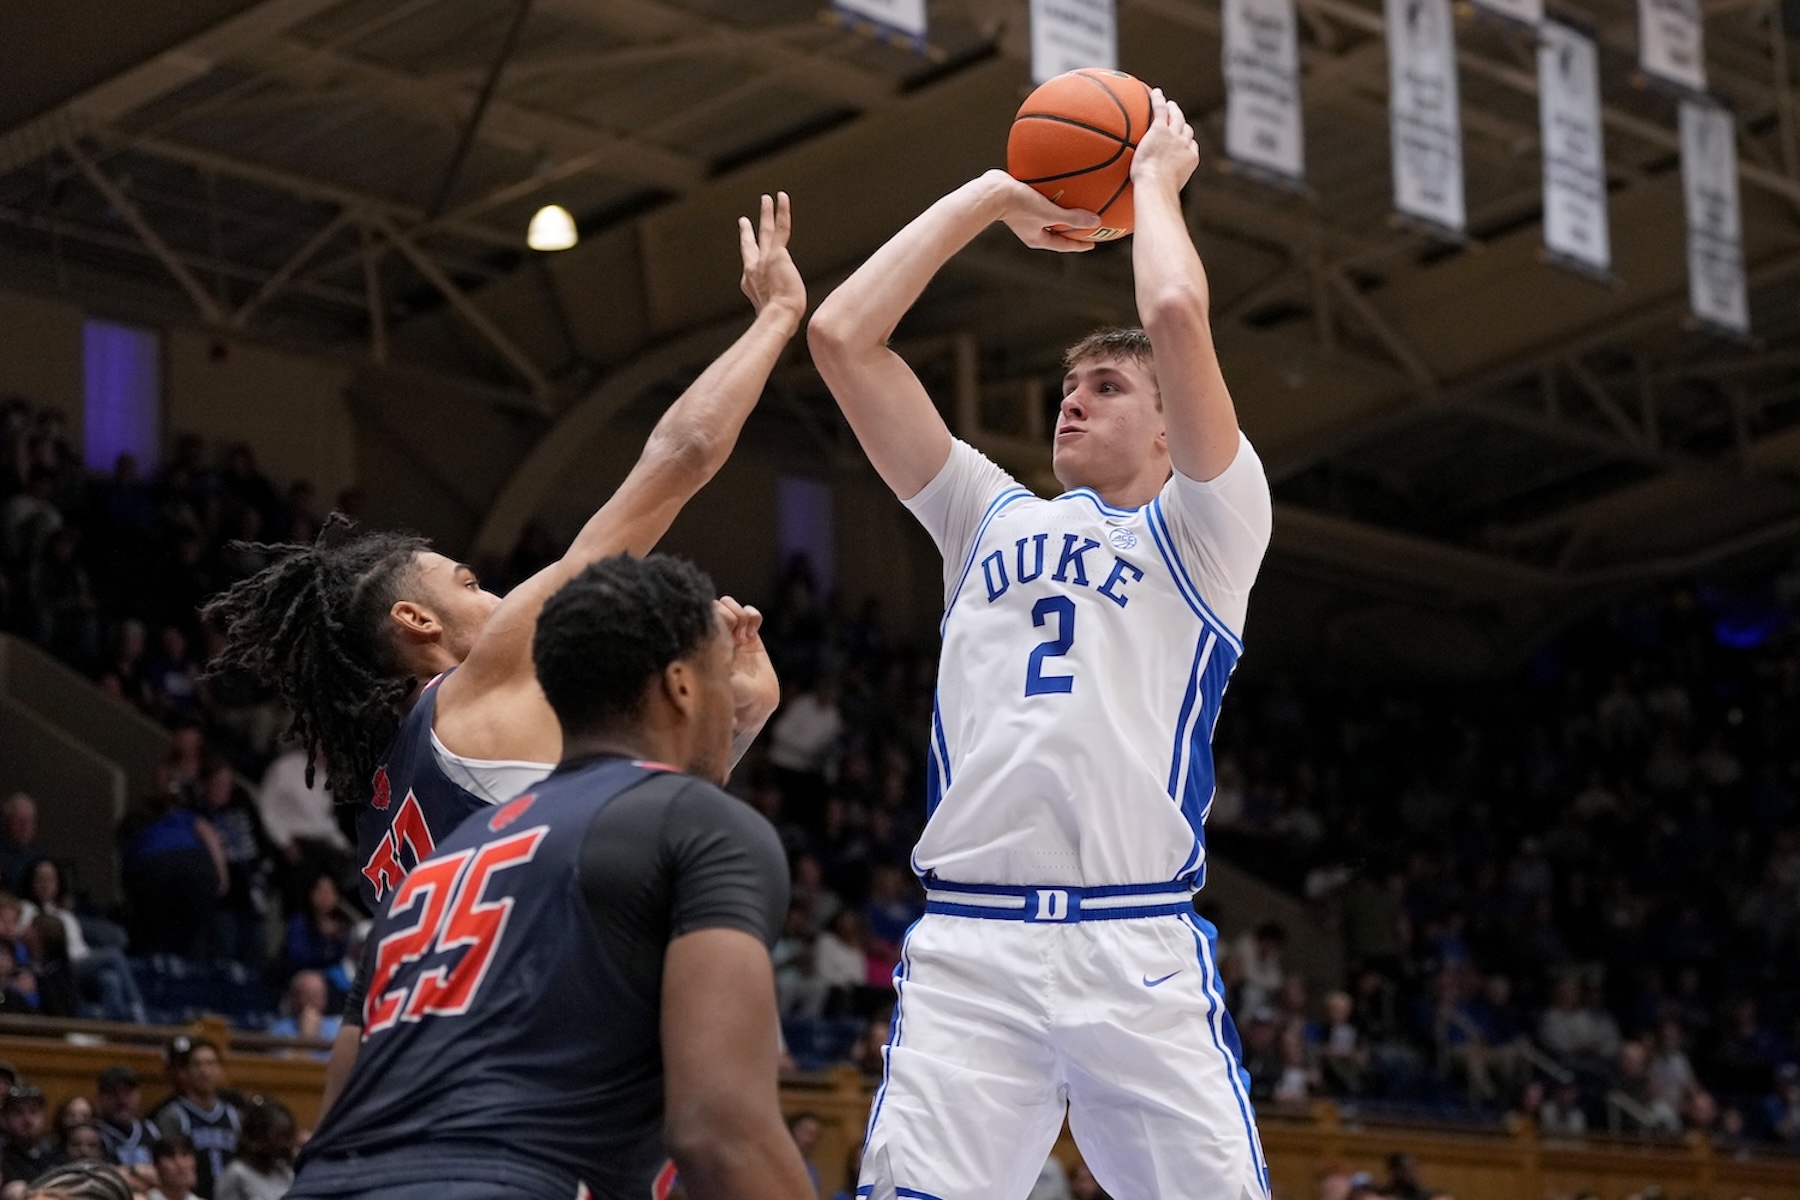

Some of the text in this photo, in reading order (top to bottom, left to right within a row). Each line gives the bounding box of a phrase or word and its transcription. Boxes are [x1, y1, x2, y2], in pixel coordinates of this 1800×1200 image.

[982, 533, 1144, 608] DUKE
[1025, 595, 1076, 698] 2
[361, 824, 551, 1043] 25
[1034, 889, 1069, 920] D
